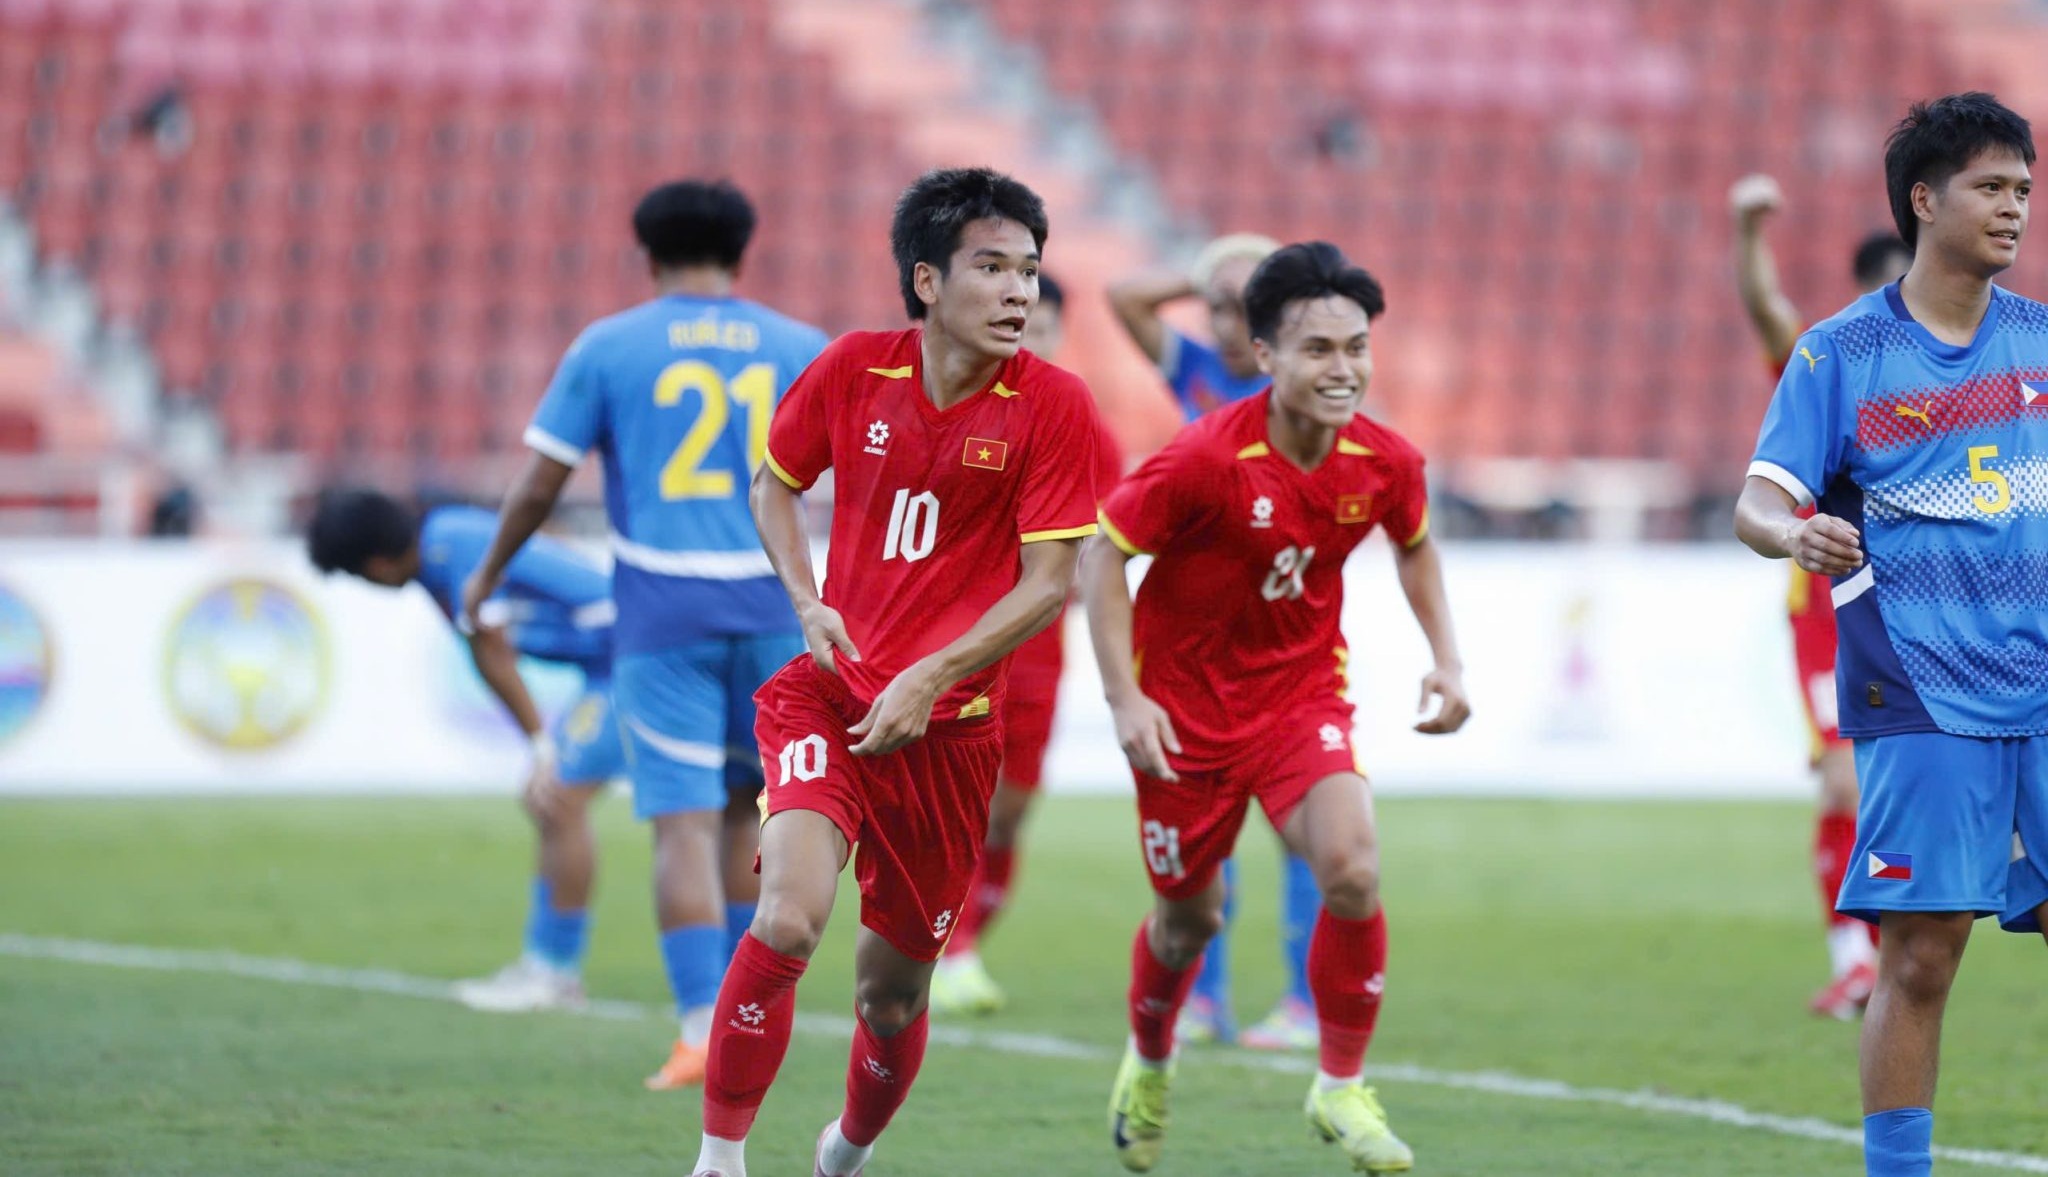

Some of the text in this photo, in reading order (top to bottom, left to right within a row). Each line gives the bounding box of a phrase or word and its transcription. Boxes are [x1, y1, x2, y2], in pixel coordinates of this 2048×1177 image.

[654, 361, 778, 501] 21
[1968, 445, 2011, 514] 5
[883, 488, 940, 563] 10
[1261, 545, 1316, 602] 21
[779, 733, 828, 786] 10
[1143, 819, 1186, 880] 21
